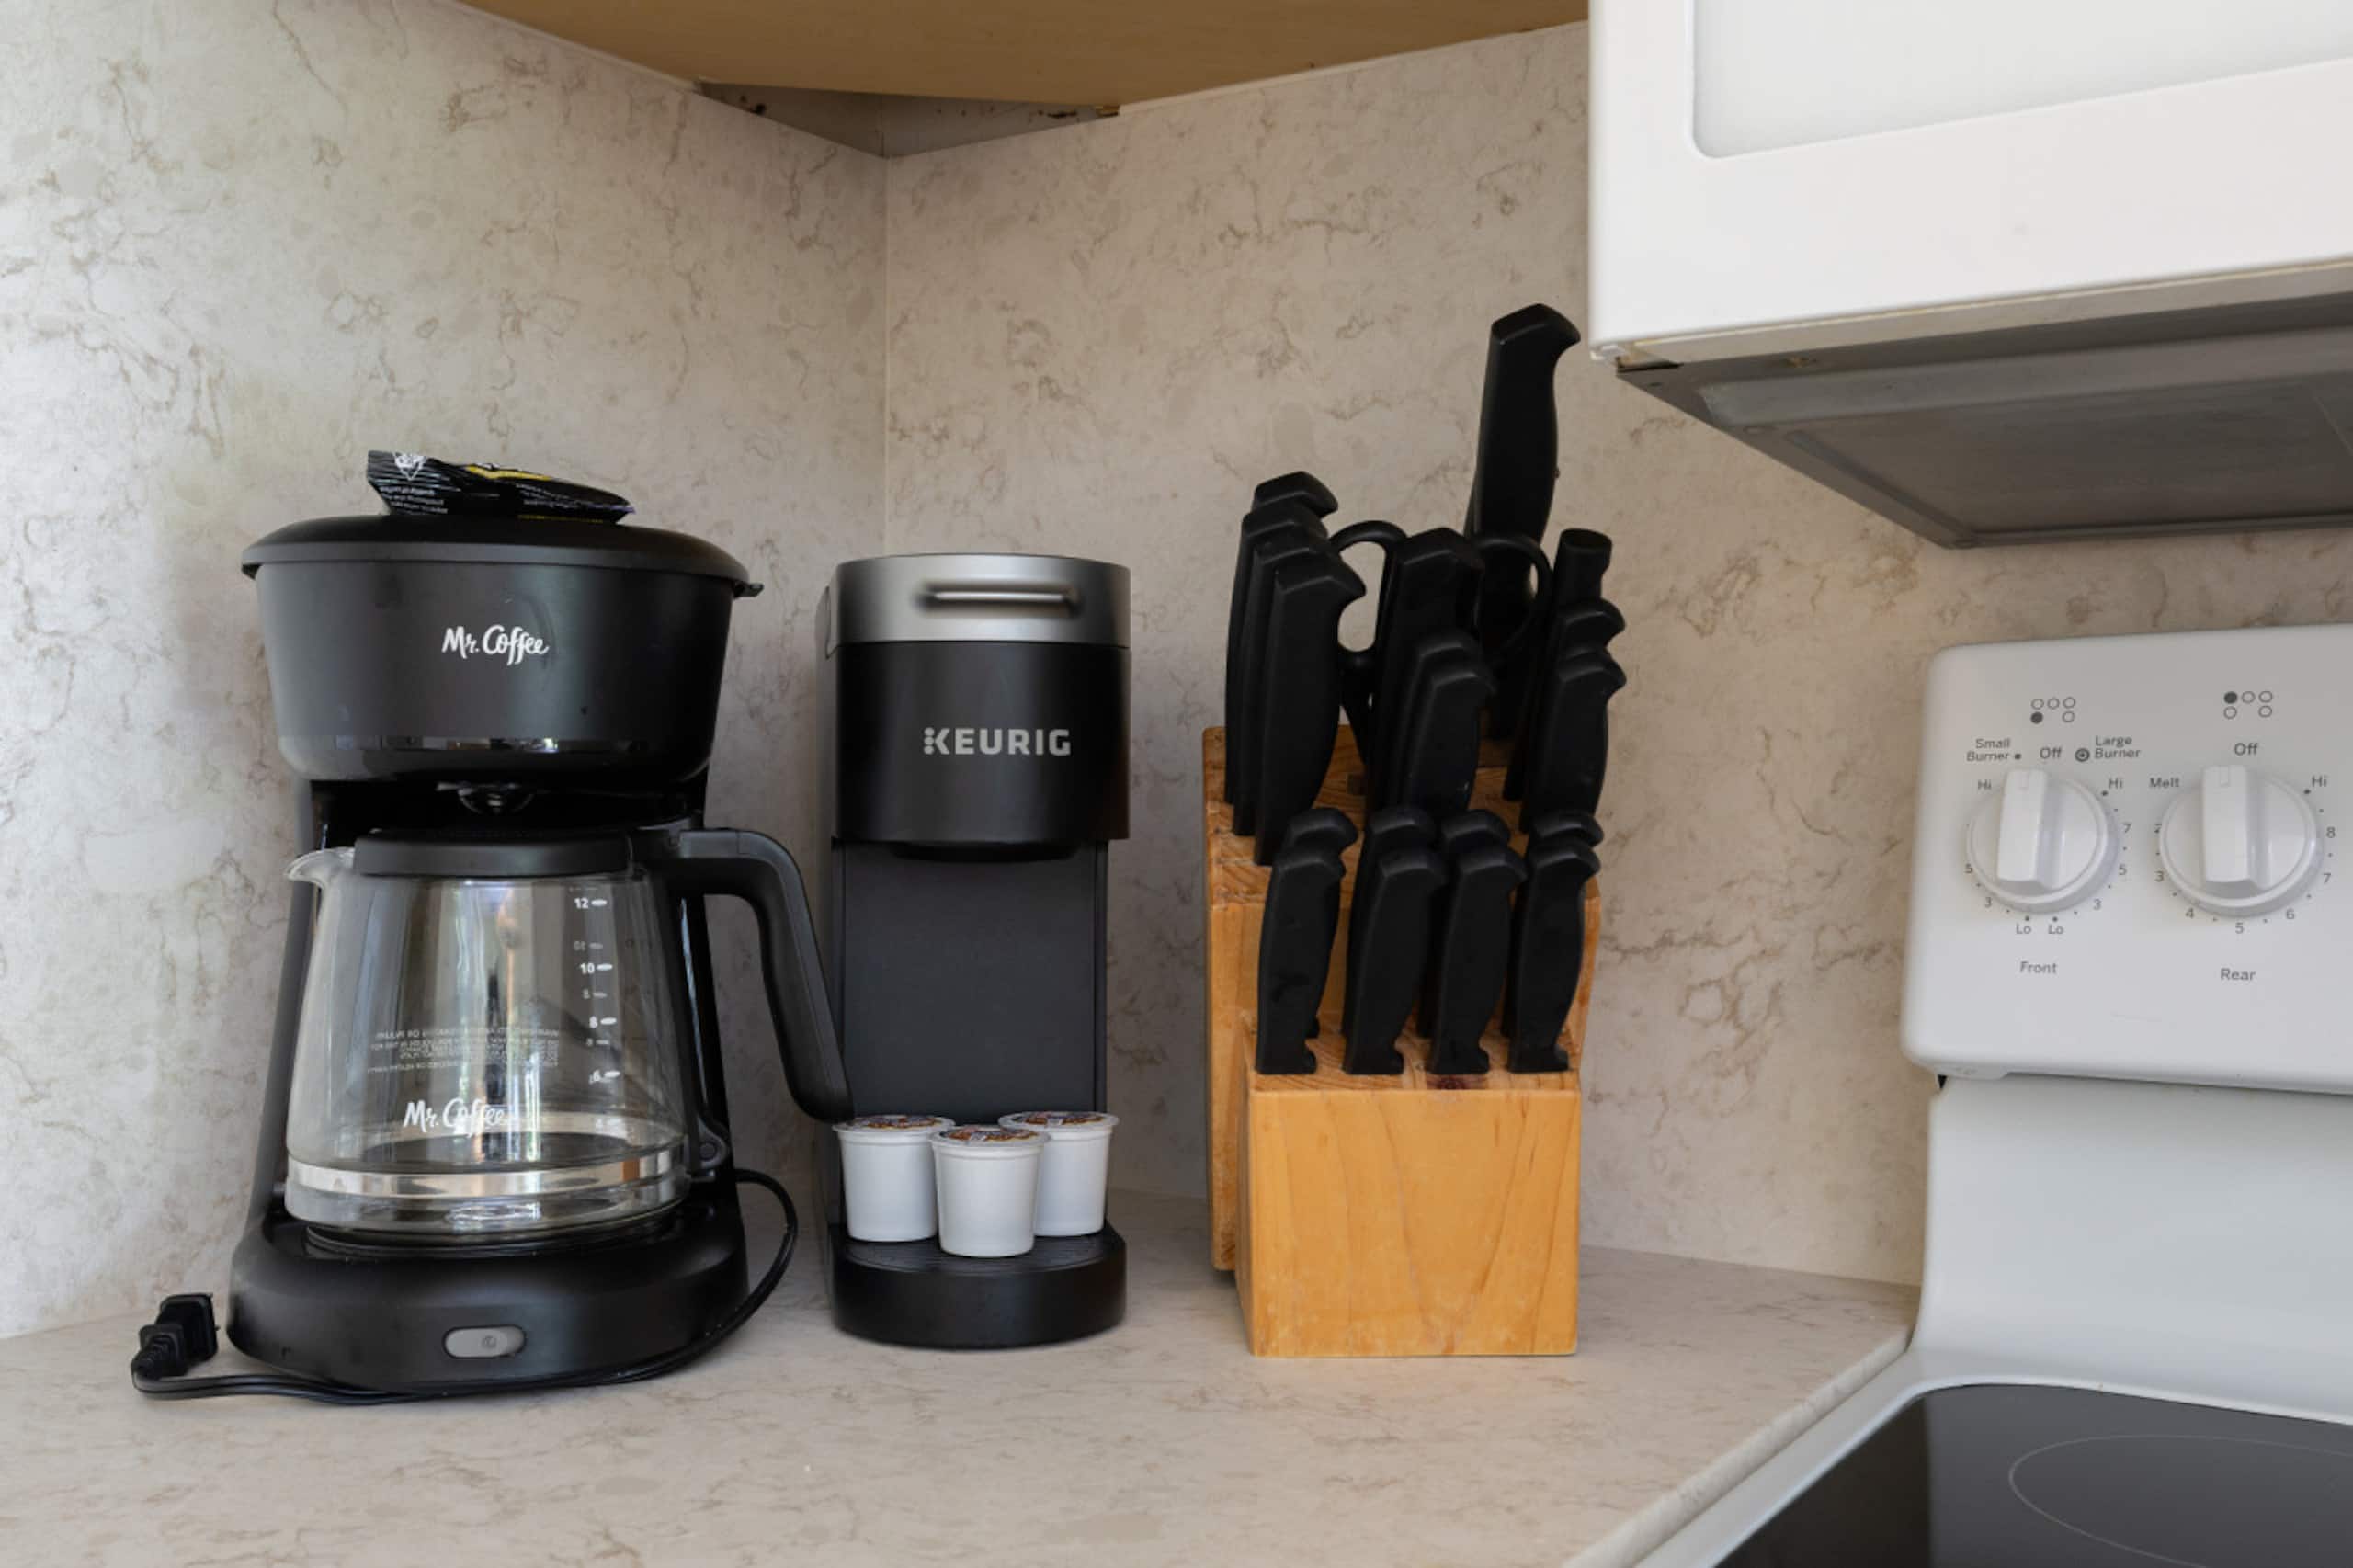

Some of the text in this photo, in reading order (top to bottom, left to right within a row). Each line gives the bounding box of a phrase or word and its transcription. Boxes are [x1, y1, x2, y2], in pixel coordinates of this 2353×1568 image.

[441, 624, 550, 665] Mr. Coffee
[923, 727, 1072, 756] KEURIG
[1975, 738, 2011, 749] Small
[2095, 735, 2132, 748] Large
[2040, 746, 2063, 759] Off
[2094, 748, 2141, 759] Burner
[2233, 742, 2258, 756] Off
[1966, 751, 2009, 762] Burner
[1977, 779, 1992, 790] Hi
[2109, 778, 2123, 789] Hi
[2149, 777, 2180, 788] Melt
[2312, 776, 2327, 787] Hi
[2123, 823, 2132, 833] 7
[2325, 826, 2336, 838] 8
[2118, 864, 2127, 875] 5
[2154, 870, 2165, 883] 3
[2323, 873, 2332, 884] 7
[574, 897, 589, 909] 12
[2093, 898, 2102, 910] 3
[2186, 907, 2195, 919] 4
[2286, 908, 2295, 920] 6
[2016, 923, 2064, 935] Lo Lo
[2234, 922, 2245, 934] 5
[580, 962, 596, 974] 10
[2019, 960, 2058, 974] Front
[2220, 968, 2256, 982] Rear
[403, 1097, 512, 1138] Mr. Coffee
